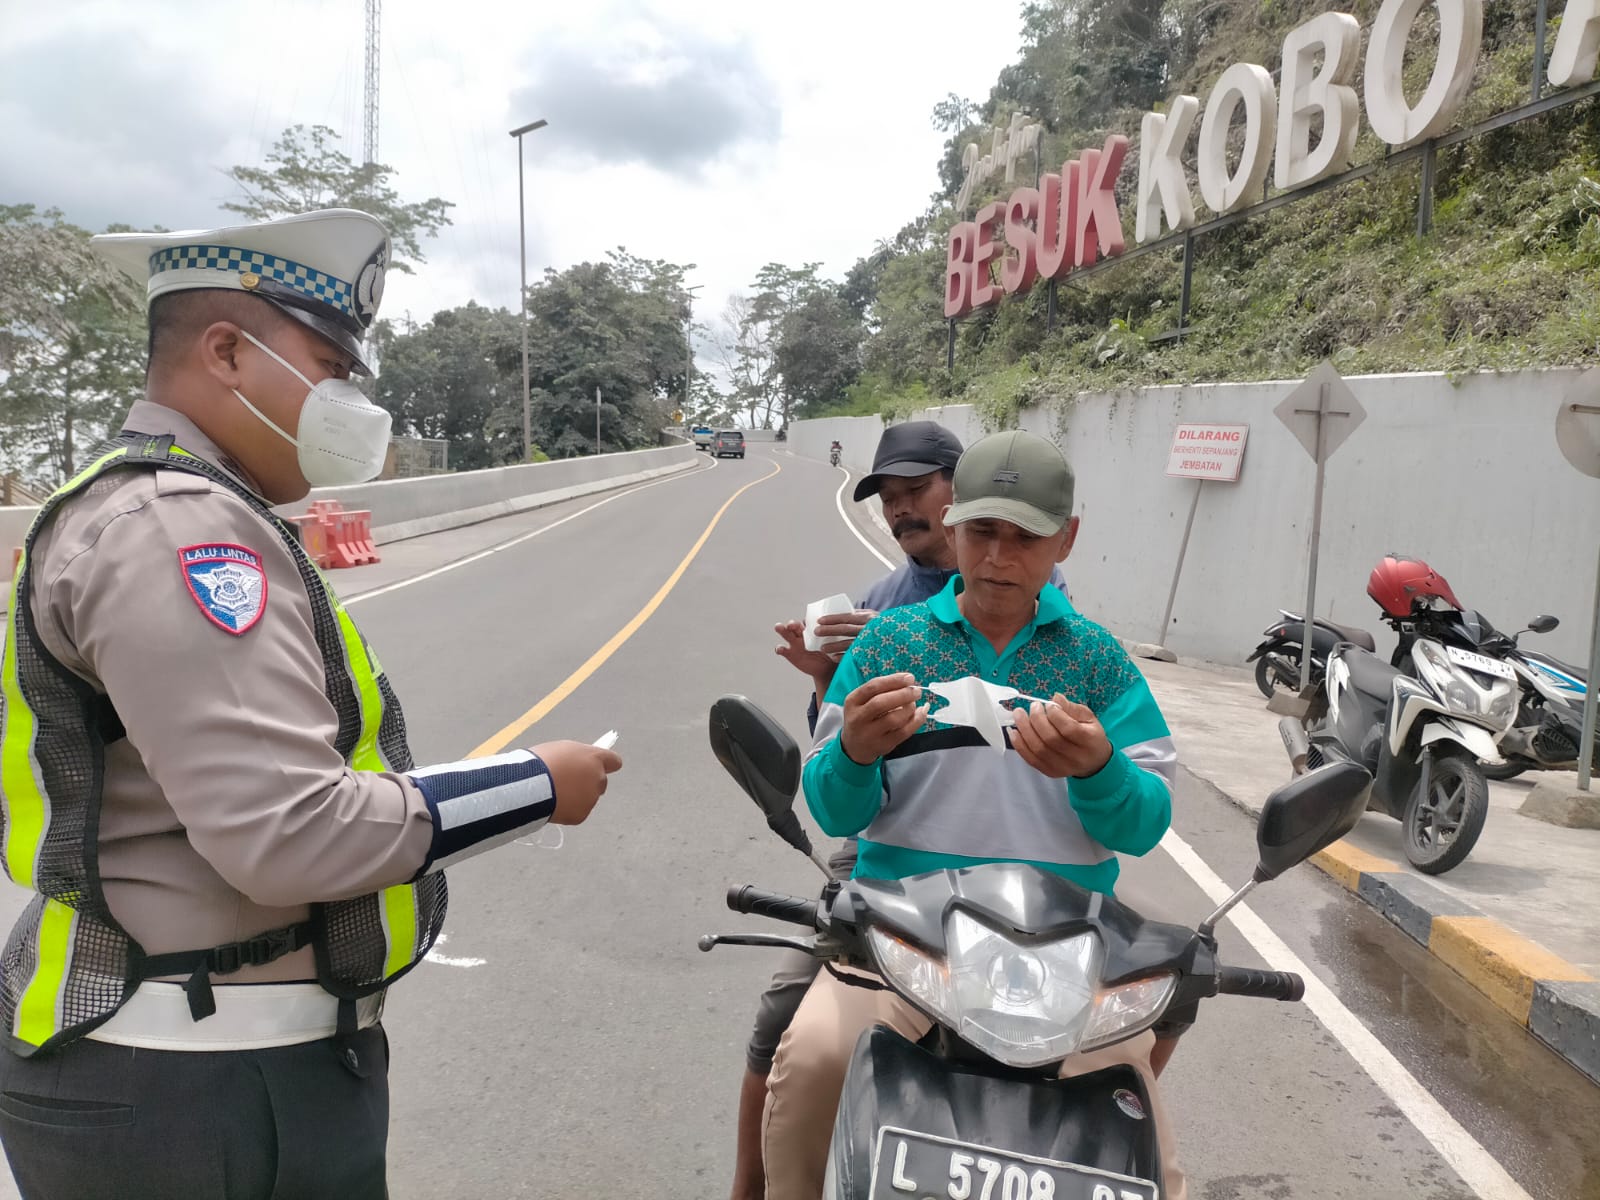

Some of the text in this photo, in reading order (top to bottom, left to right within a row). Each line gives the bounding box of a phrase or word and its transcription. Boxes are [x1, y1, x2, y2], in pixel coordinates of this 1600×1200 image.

[944, 0, 1600, 318] BESUK KOBO
[1178, 430, 1240, 442] DILARANG
[1173, 445, 1238, 457] BERHENTI SEPANJANG
[1179, 460, 1222, 472] JEMBATAN
[186, 547, 257, 564] LALU LINTAS
[892, 1140, 1056, 1200] L 5708
